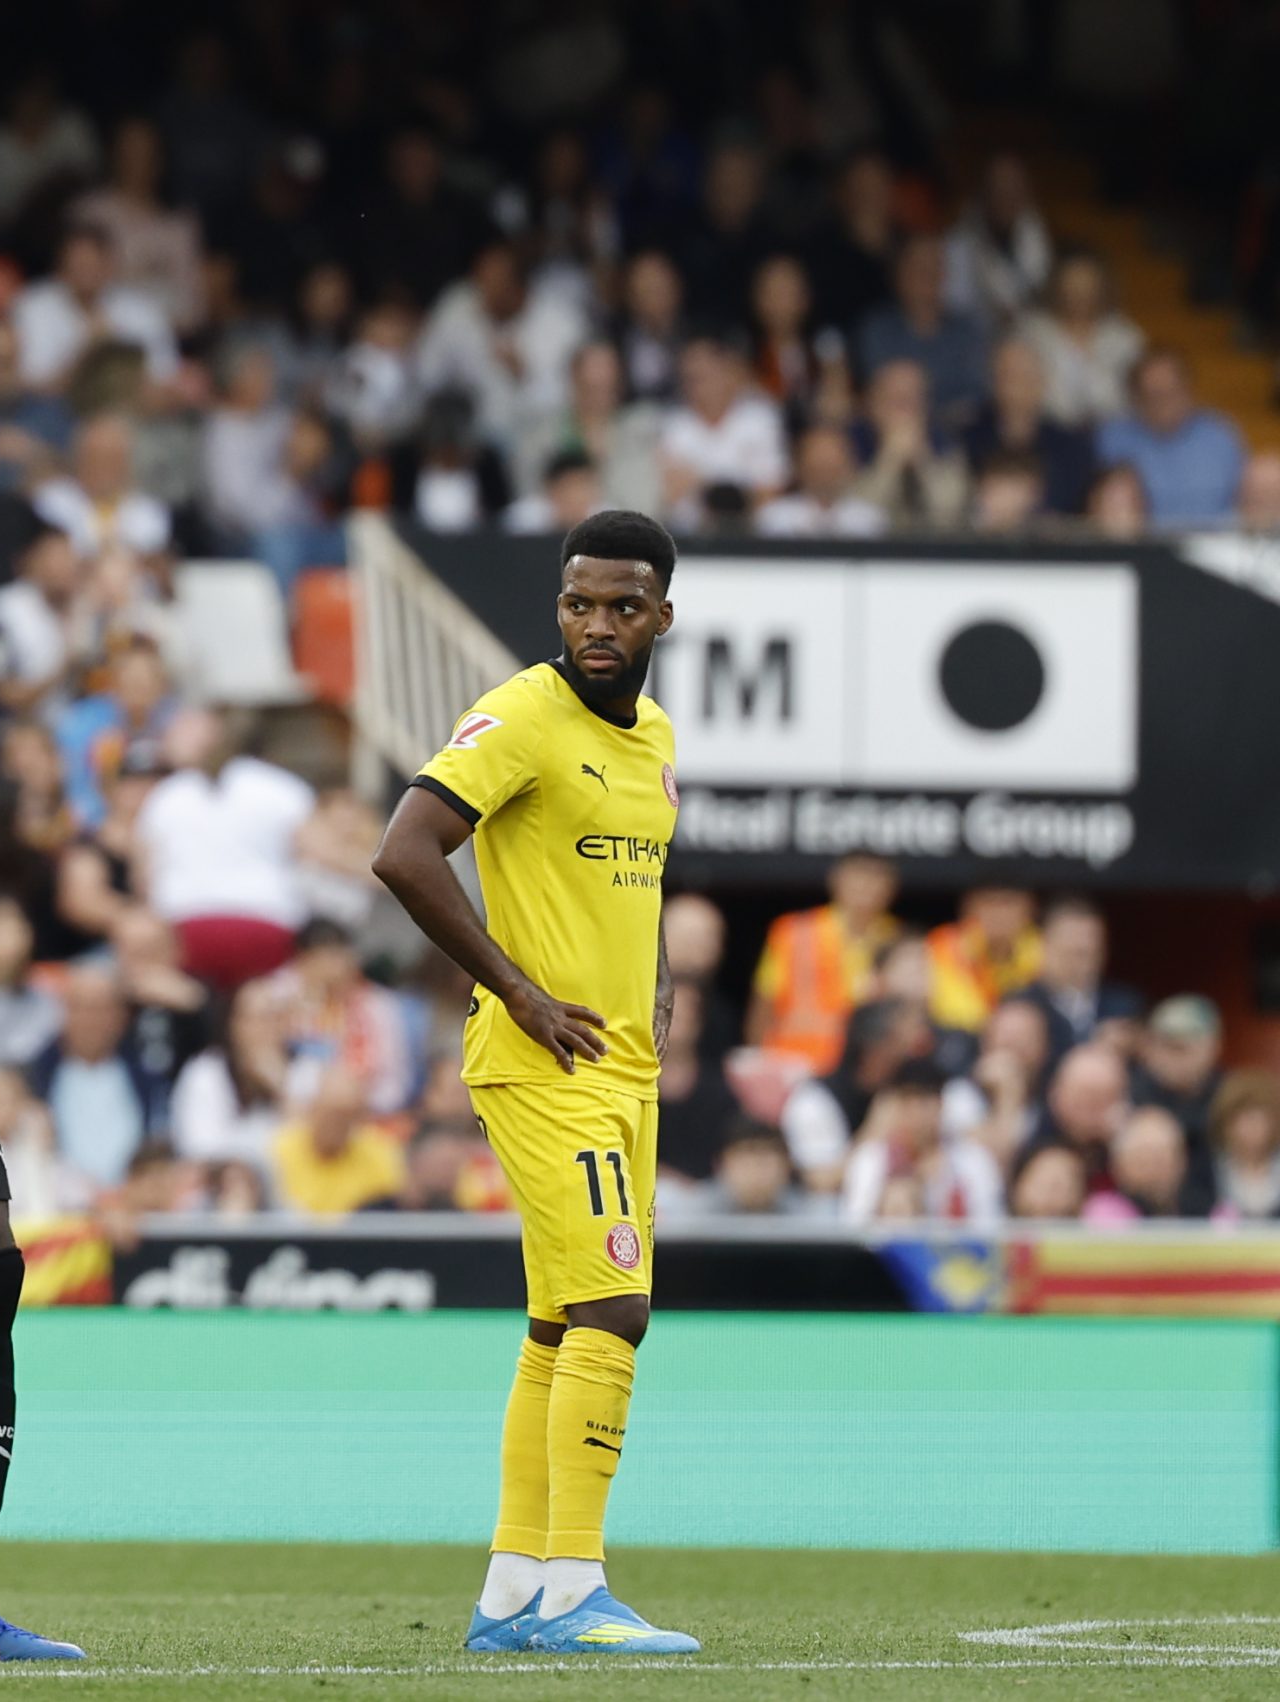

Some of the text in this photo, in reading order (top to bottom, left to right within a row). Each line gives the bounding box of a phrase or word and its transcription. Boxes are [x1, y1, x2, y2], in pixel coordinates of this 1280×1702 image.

[678, 790, 1134, 868] Real Estate Group
[576, 1151, 629, 1216] 11
